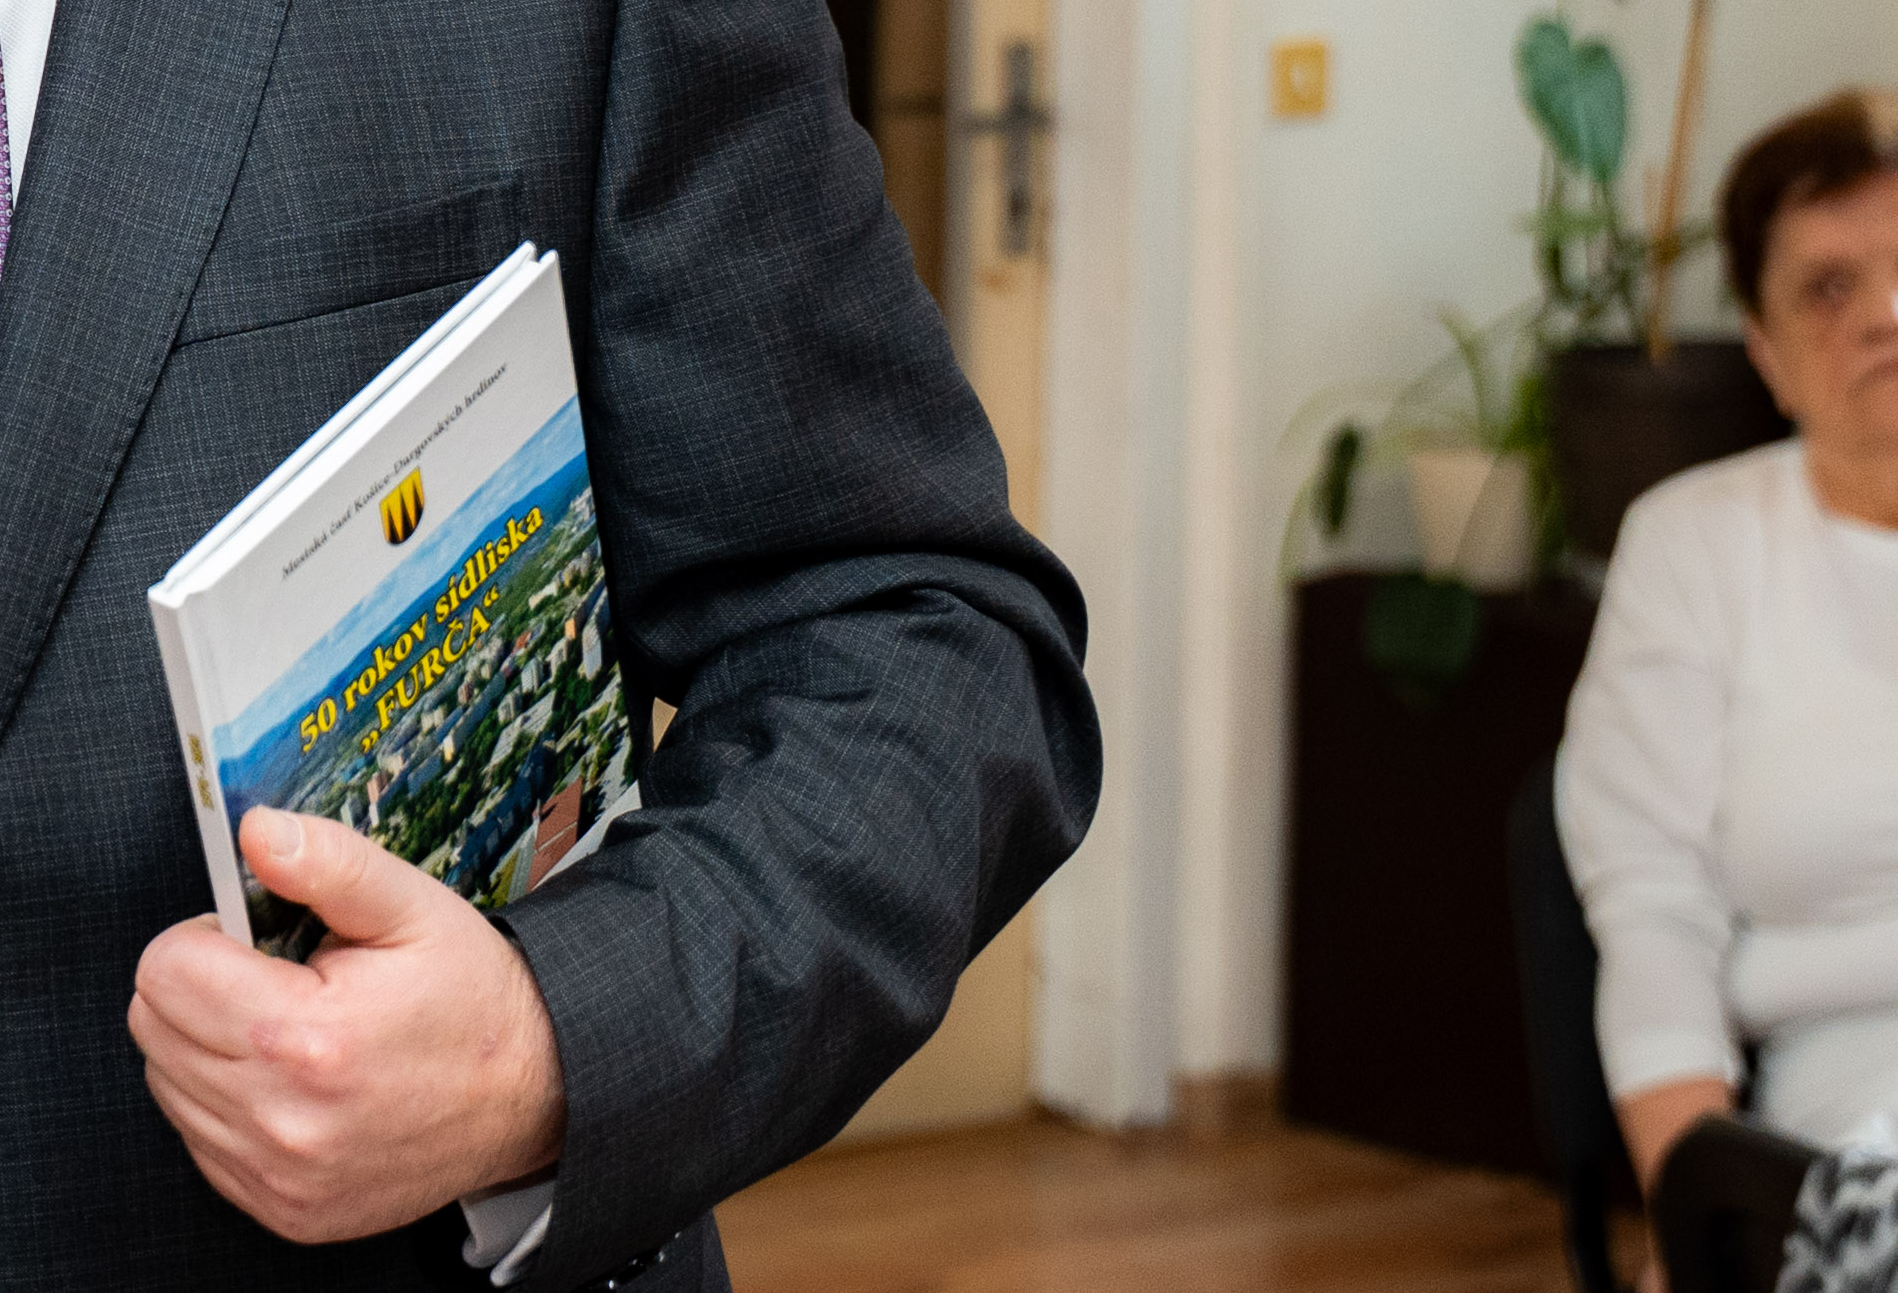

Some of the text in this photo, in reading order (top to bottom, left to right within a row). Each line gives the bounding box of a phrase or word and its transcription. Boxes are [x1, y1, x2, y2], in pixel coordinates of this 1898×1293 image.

[463, 362, 508, 408] hrdinov
[299, 505, 544, 753] 50 rokov sídliska
[360, 584, 501, 754] „FURČA“
